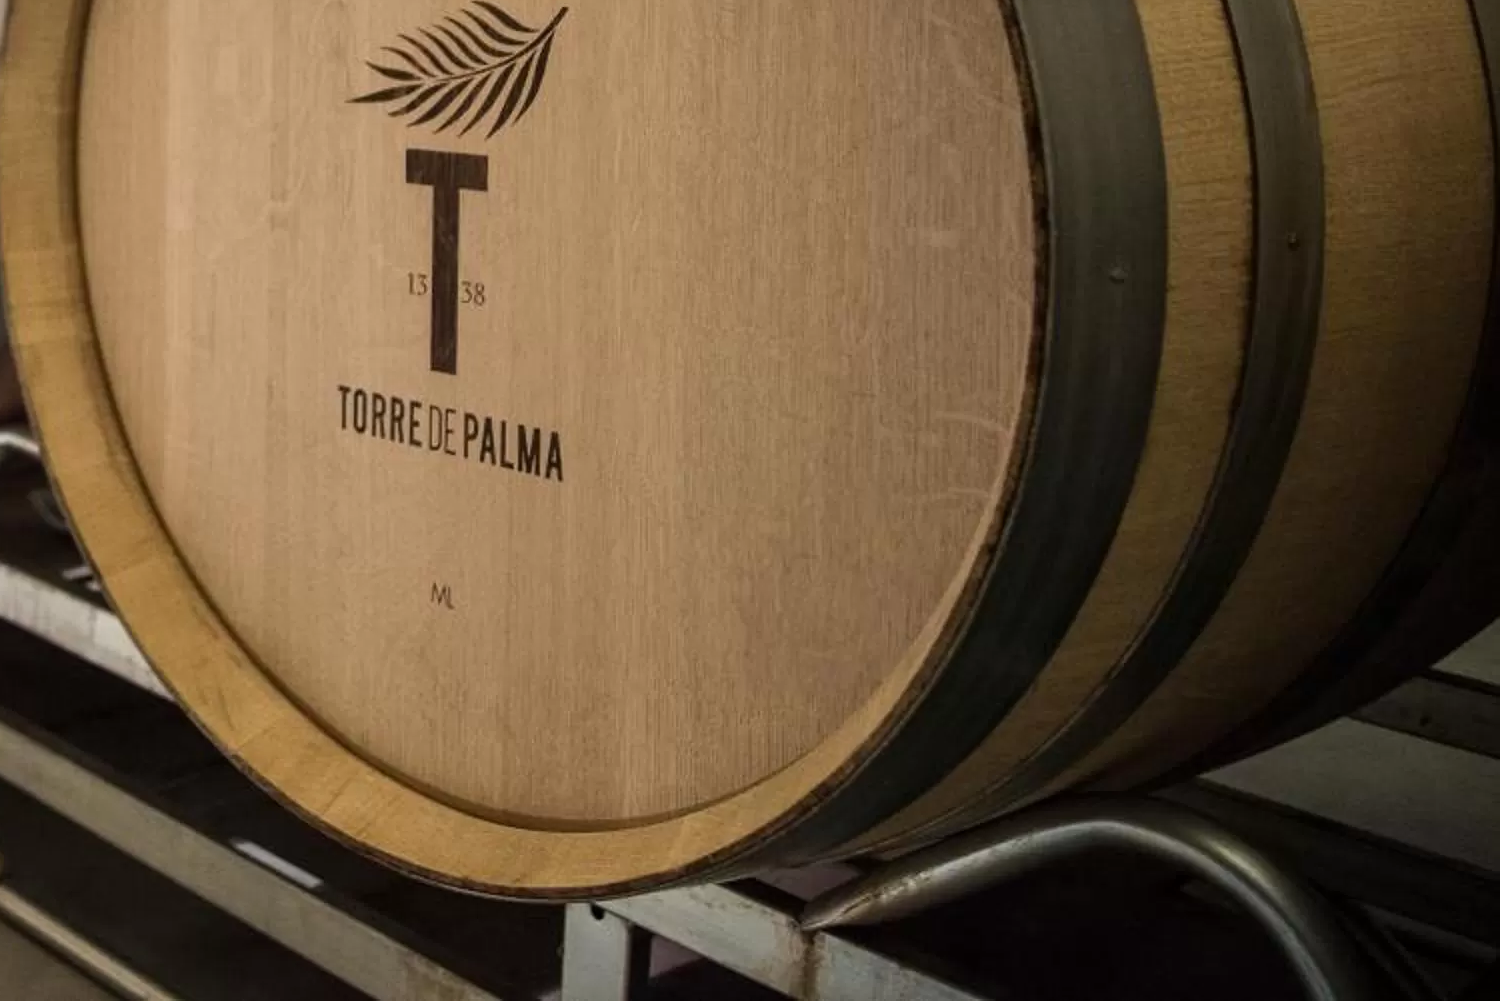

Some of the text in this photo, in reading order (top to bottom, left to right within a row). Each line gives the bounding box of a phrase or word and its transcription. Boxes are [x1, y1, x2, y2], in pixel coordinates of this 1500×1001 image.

[406, 148, 488, 375] T
[408, 272, 485, 305] 13 38
[338, 385, 423, 447] TORRE
[463, 412, 564, 482] PALMA
